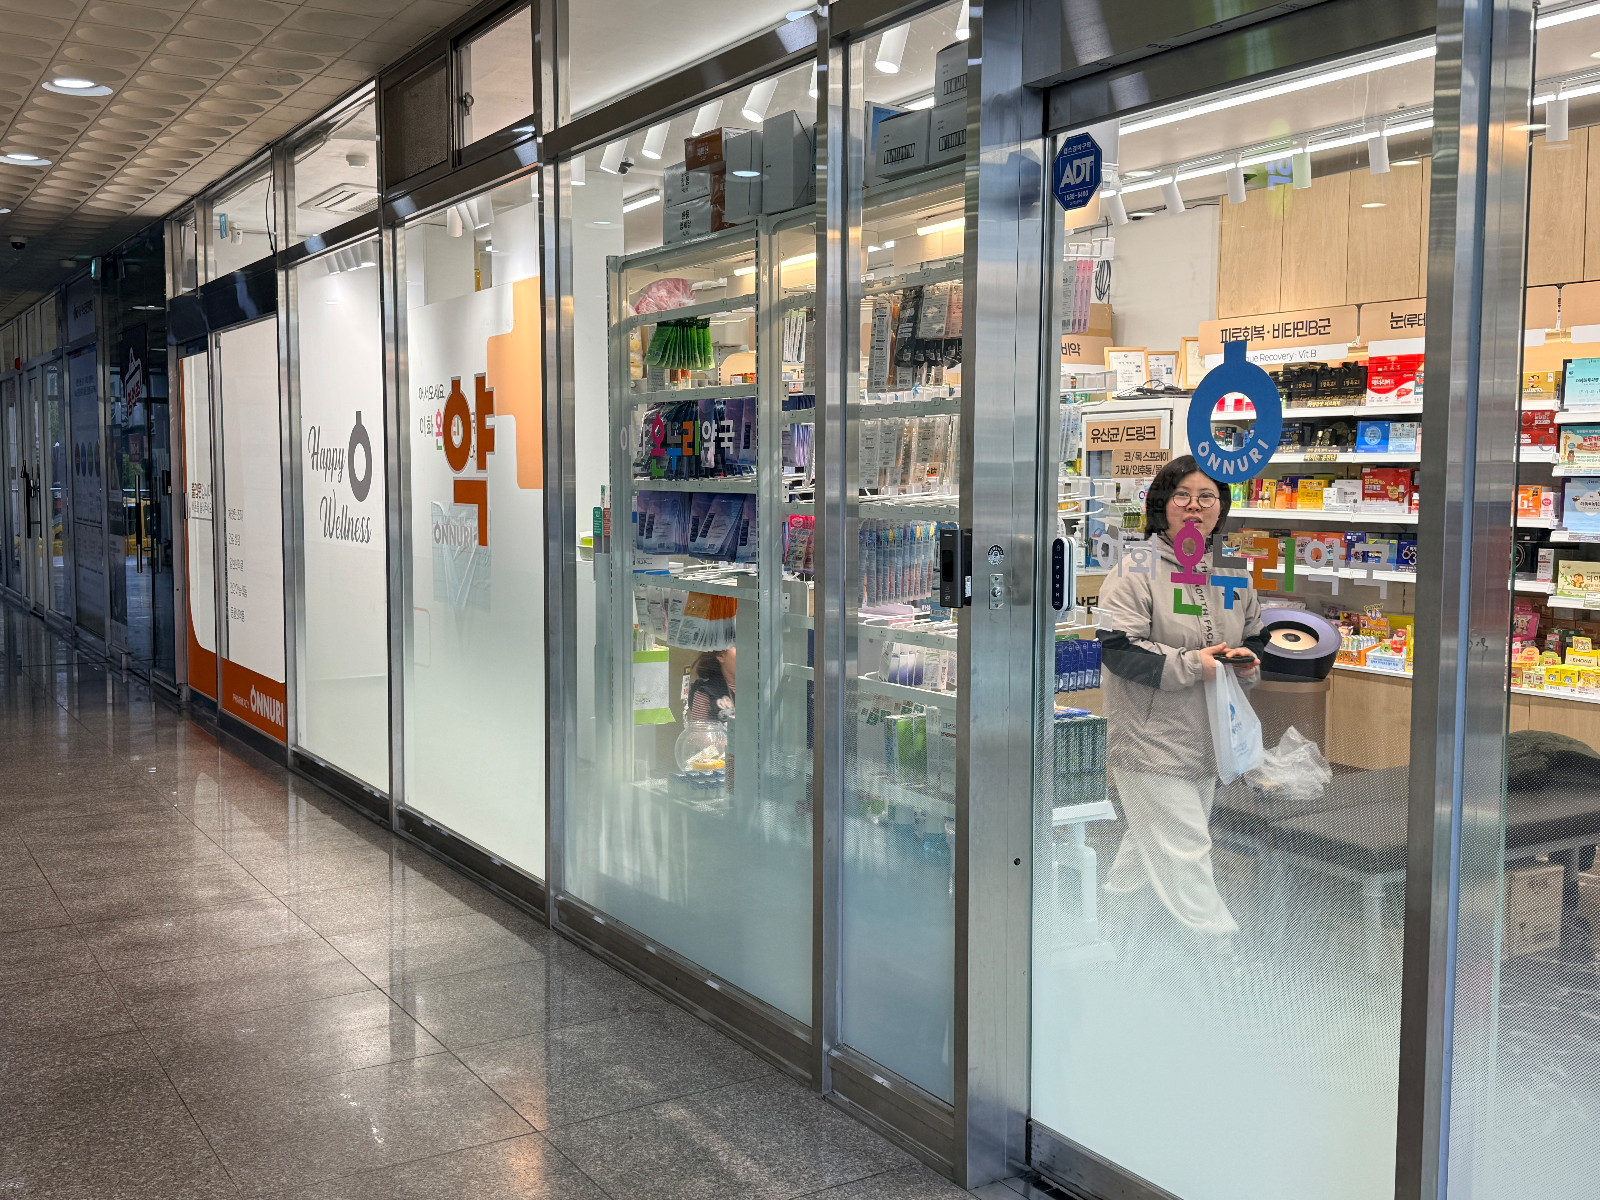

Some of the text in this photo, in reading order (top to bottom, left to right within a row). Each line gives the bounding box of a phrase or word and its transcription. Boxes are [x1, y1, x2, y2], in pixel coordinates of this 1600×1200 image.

[1060, 155, 1095, 188] ADT
[1259, 352, 1295, 363] Recovery
[1091, 425, 1157, 443] 유산균/드링크
[307, 425, 345, 484] Happy
[1197, 438, 1270, 475] ONNURI
[318, 491, 372, 544] Wellness
[433, 520, 475, 548] ONNURI
[250, 684, 285, 728] ONNURI
